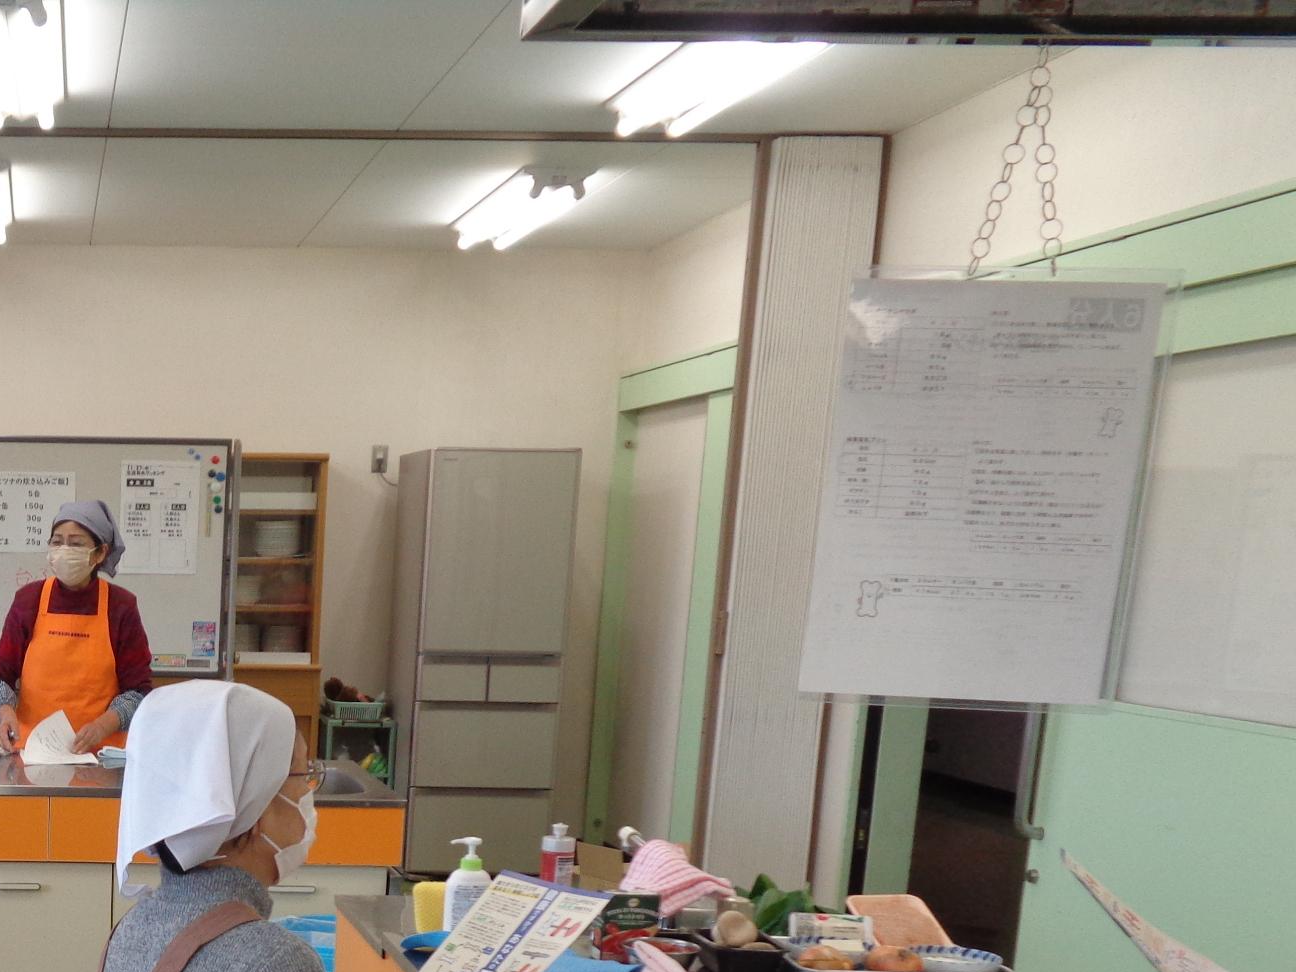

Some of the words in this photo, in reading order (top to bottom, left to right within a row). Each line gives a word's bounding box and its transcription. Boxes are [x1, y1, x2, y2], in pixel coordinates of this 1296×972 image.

[24, 502, 44, 511] 150g
[26, 514, 42, 523] 30g
[26, 526, 42, 535] 75g
[26, 538, 41, 546] 25g
